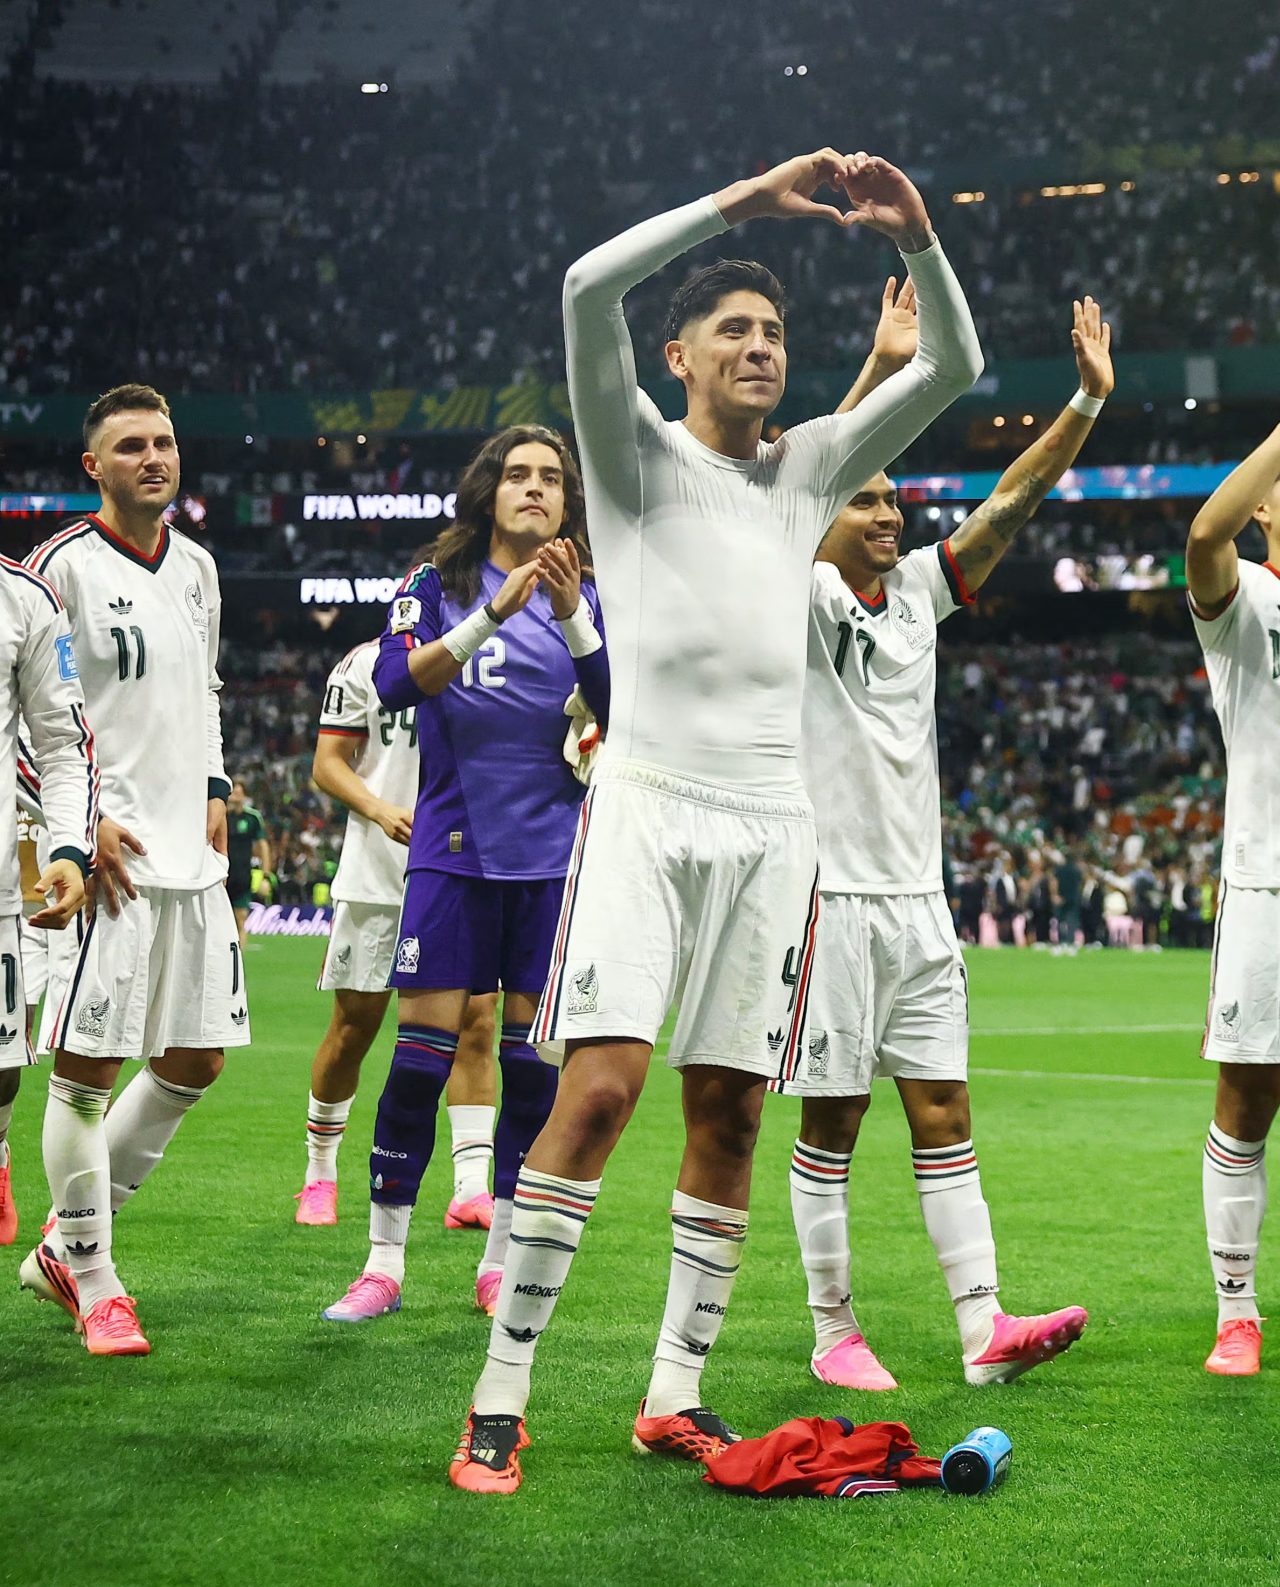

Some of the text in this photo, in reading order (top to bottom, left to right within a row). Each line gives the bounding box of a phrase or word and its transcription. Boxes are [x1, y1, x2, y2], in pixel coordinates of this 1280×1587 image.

[303, 495, 356, 520] FIFA
[356, 494, 443, 519] WORLD
[300, 578, 355, 604] FIFA
[110, 625, 146, 682] 11
[461, 637, 507, 689] 12
[834, 621, 876, 687] 17
[378, 705, 417, 748] 24
[244, 902, 331, 936] Michelo
[230, 942, 240, 996] 1
[781, 946, 802, 1014] 4
[514, 1283, 561, 1298] MÉXICO
[695, 1302, 727, 1316] MÉXI
